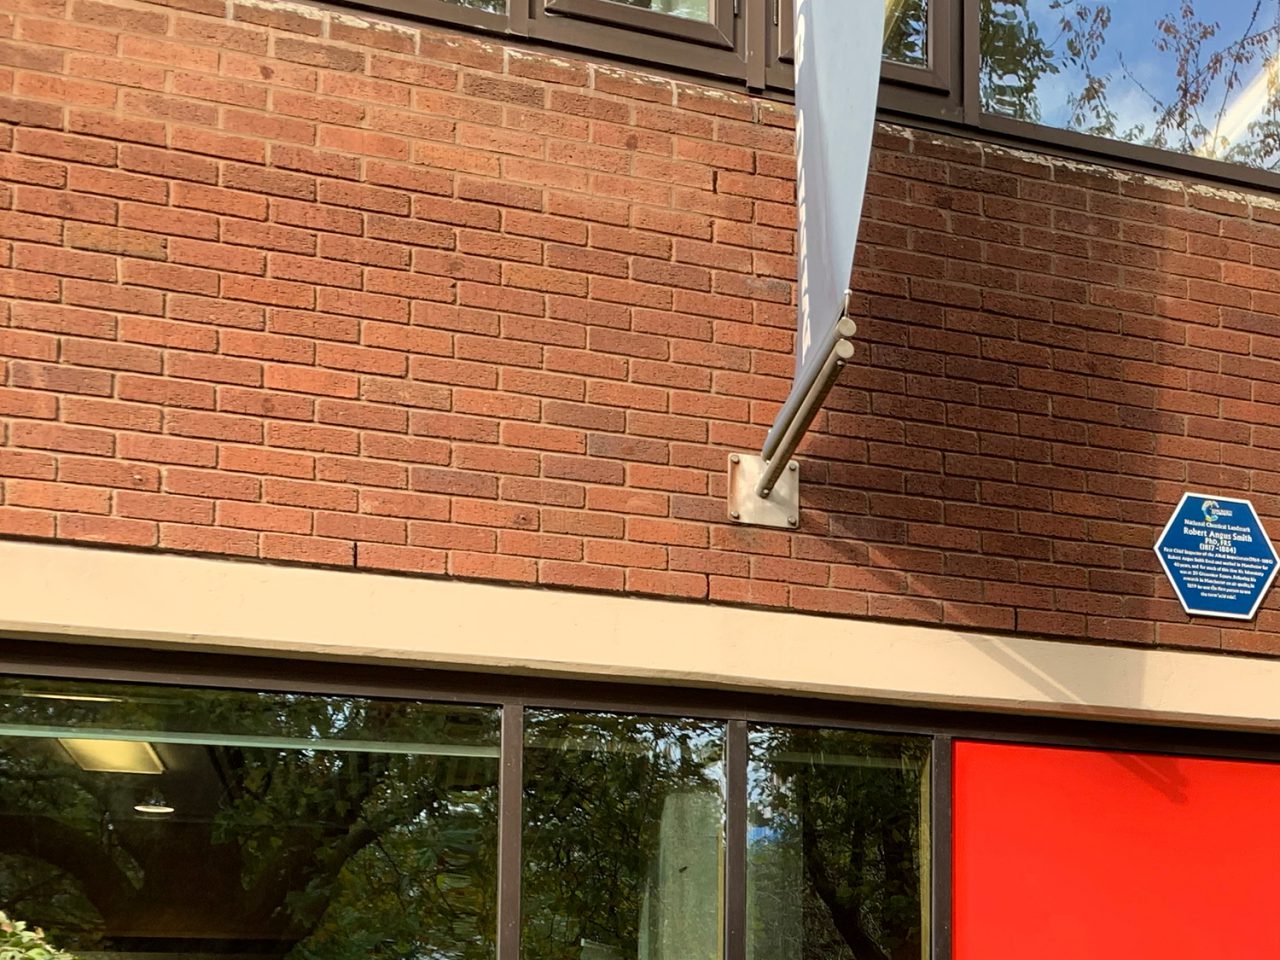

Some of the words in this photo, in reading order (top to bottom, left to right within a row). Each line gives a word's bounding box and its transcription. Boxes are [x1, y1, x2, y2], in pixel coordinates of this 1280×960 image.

[1183, 527, 1207, 537] Robert
[1209, 531, 1232, 541] Angus
[1232, 533, 1253, 542] Smith
[1204, 537, 1220, 546] PhD,
